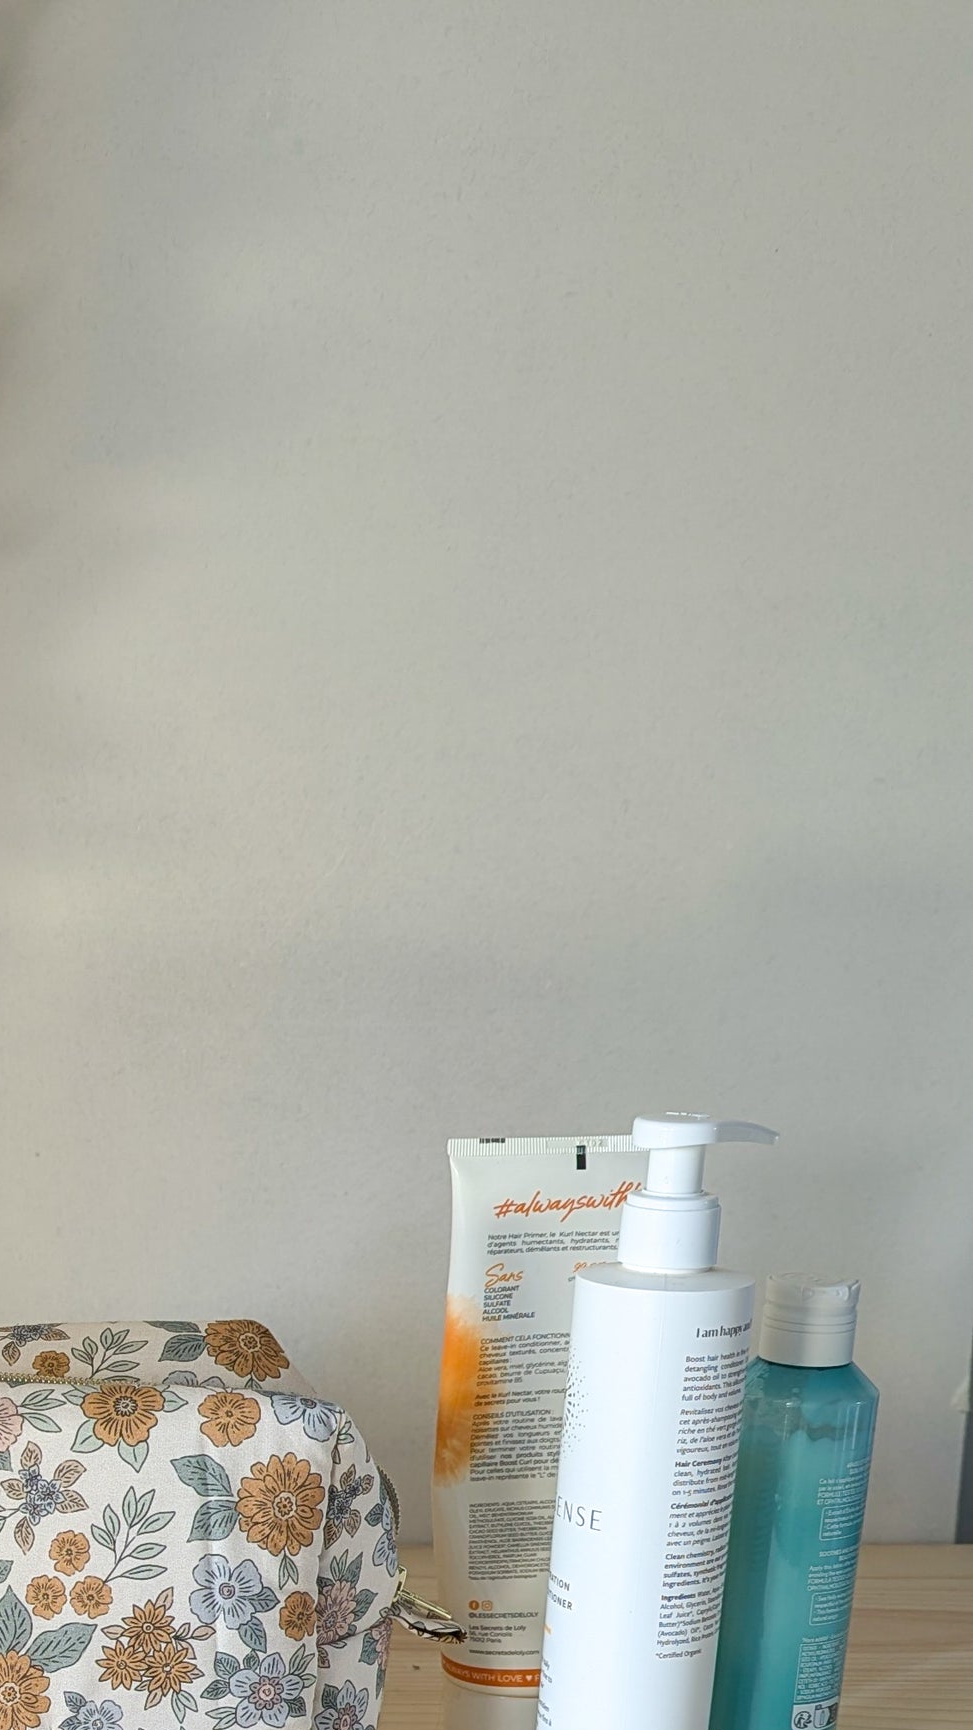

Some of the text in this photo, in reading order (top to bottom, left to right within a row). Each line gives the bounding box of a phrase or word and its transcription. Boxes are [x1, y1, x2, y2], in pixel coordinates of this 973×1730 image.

[485, 1263, 523, 1288] Sans
[484, 1285, 519, 1294] COLORANT
[503, 1312, 535, 1320] MINÉRALE
[696, 1328, 700, 1338] I
[702, 1329, 718, 1337] am
[481, 1336, 514, 1344] COMMENT
[685, 1365, 718, 1373] detangling
[473, 1412, 504, 1420] CONSEILS
[472, 1672, 497, 1681] WITH
[497, 1674, 523, 1682] LOVE
